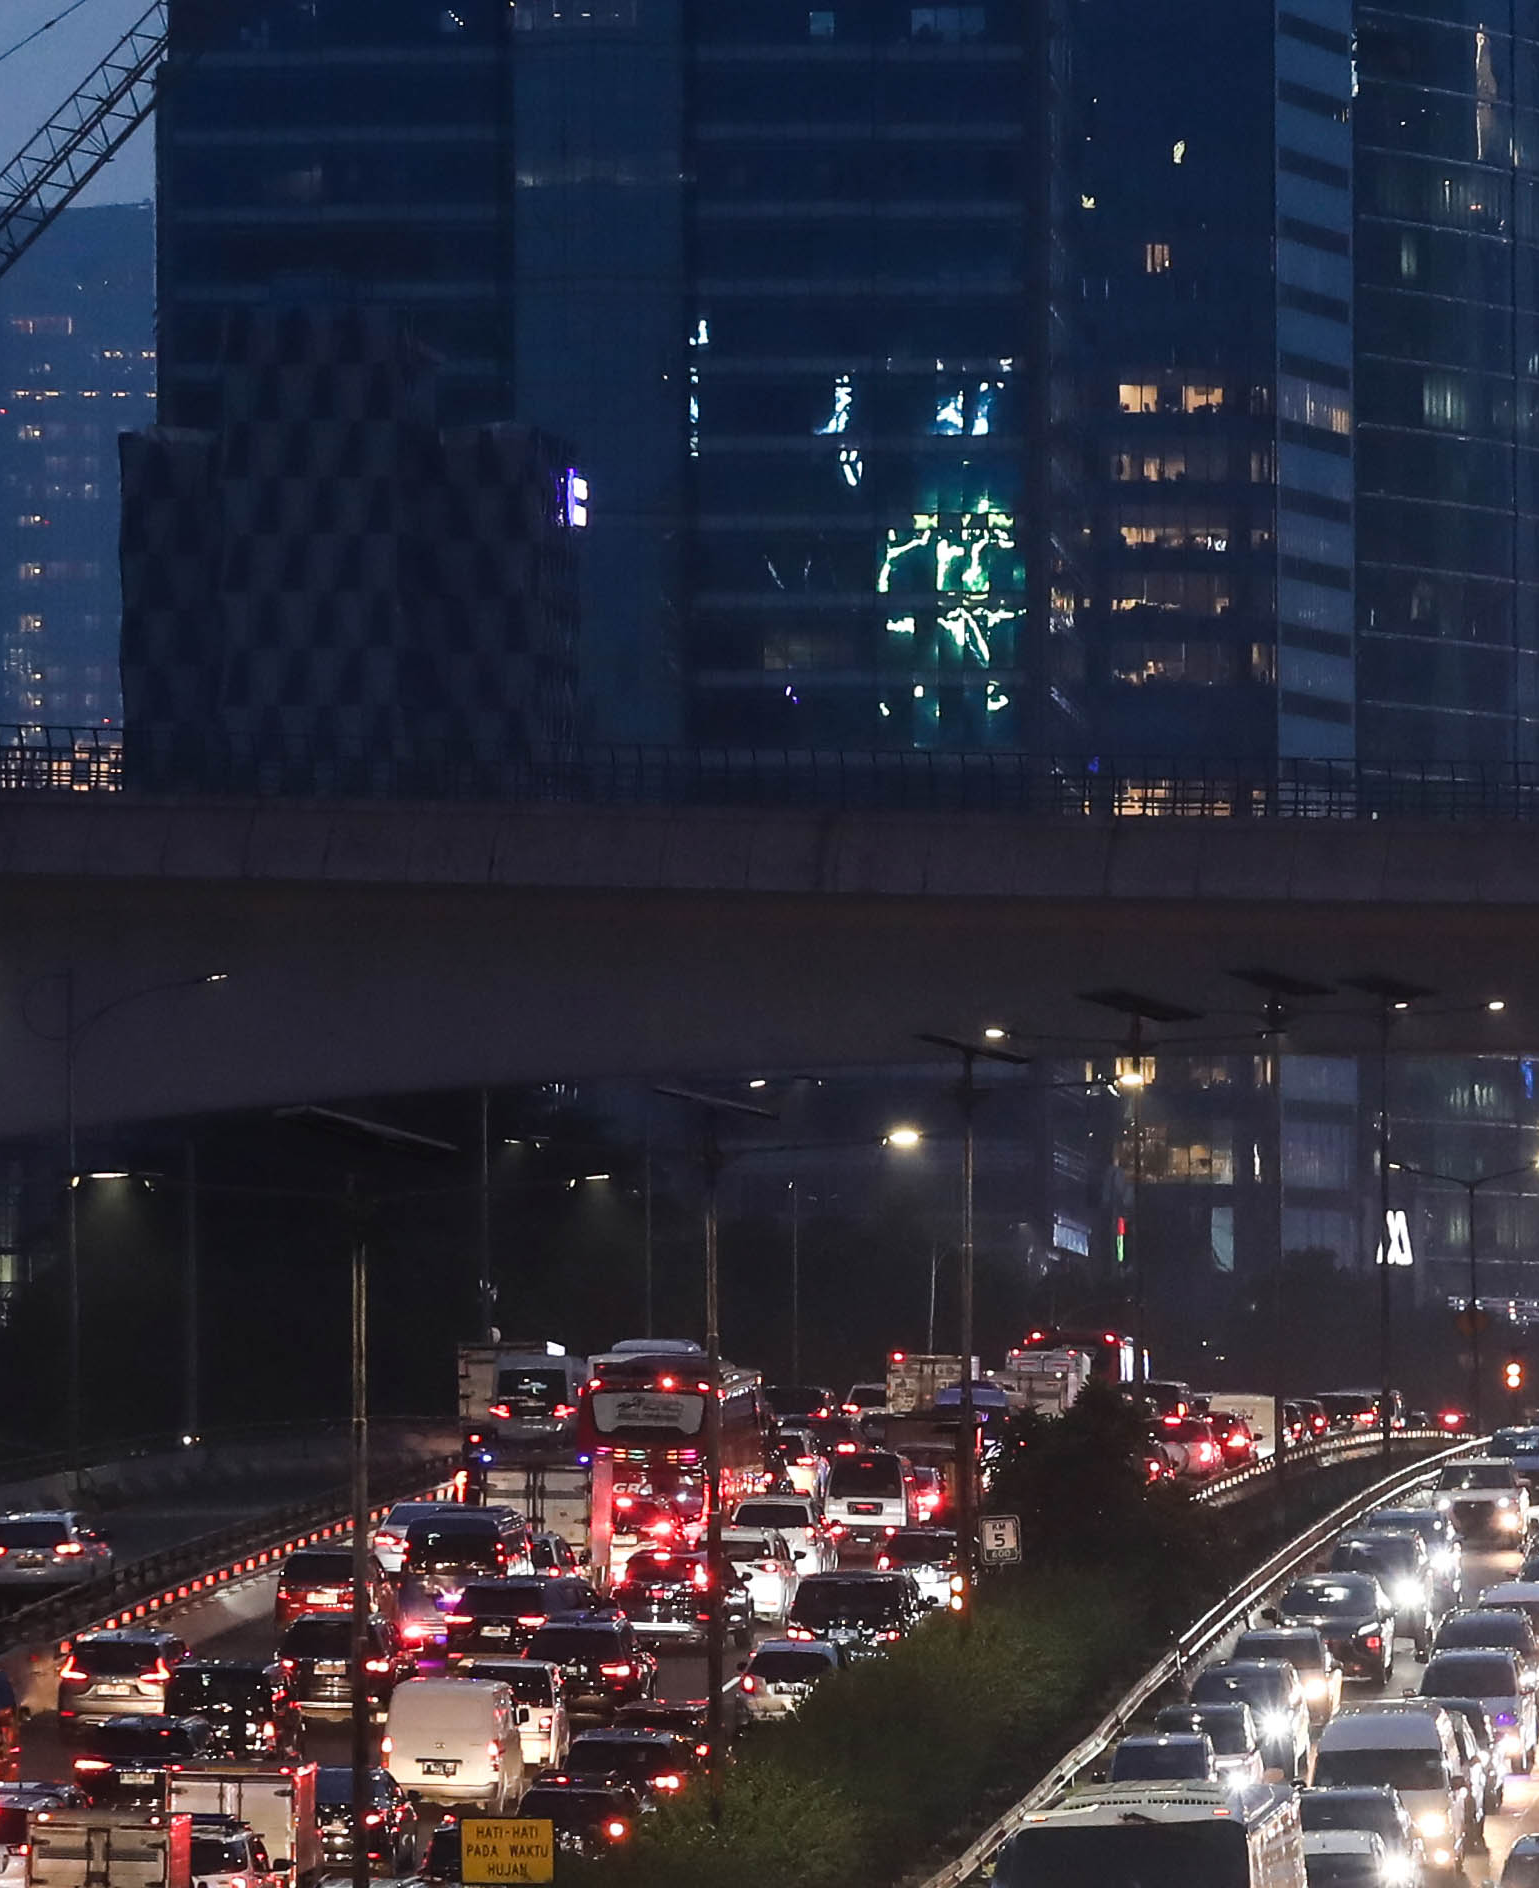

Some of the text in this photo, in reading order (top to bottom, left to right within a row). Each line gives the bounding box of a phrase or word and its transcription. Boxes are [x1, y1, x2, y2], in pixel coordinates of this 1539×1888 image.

[994, 1533, 1006, 1547] 5
[476, 1826, 539, 1839] HATI-HATI
[466, 1844, 549, 1858] PADA WAKTU
[487, 1863, 528, 1877] HUJAN
